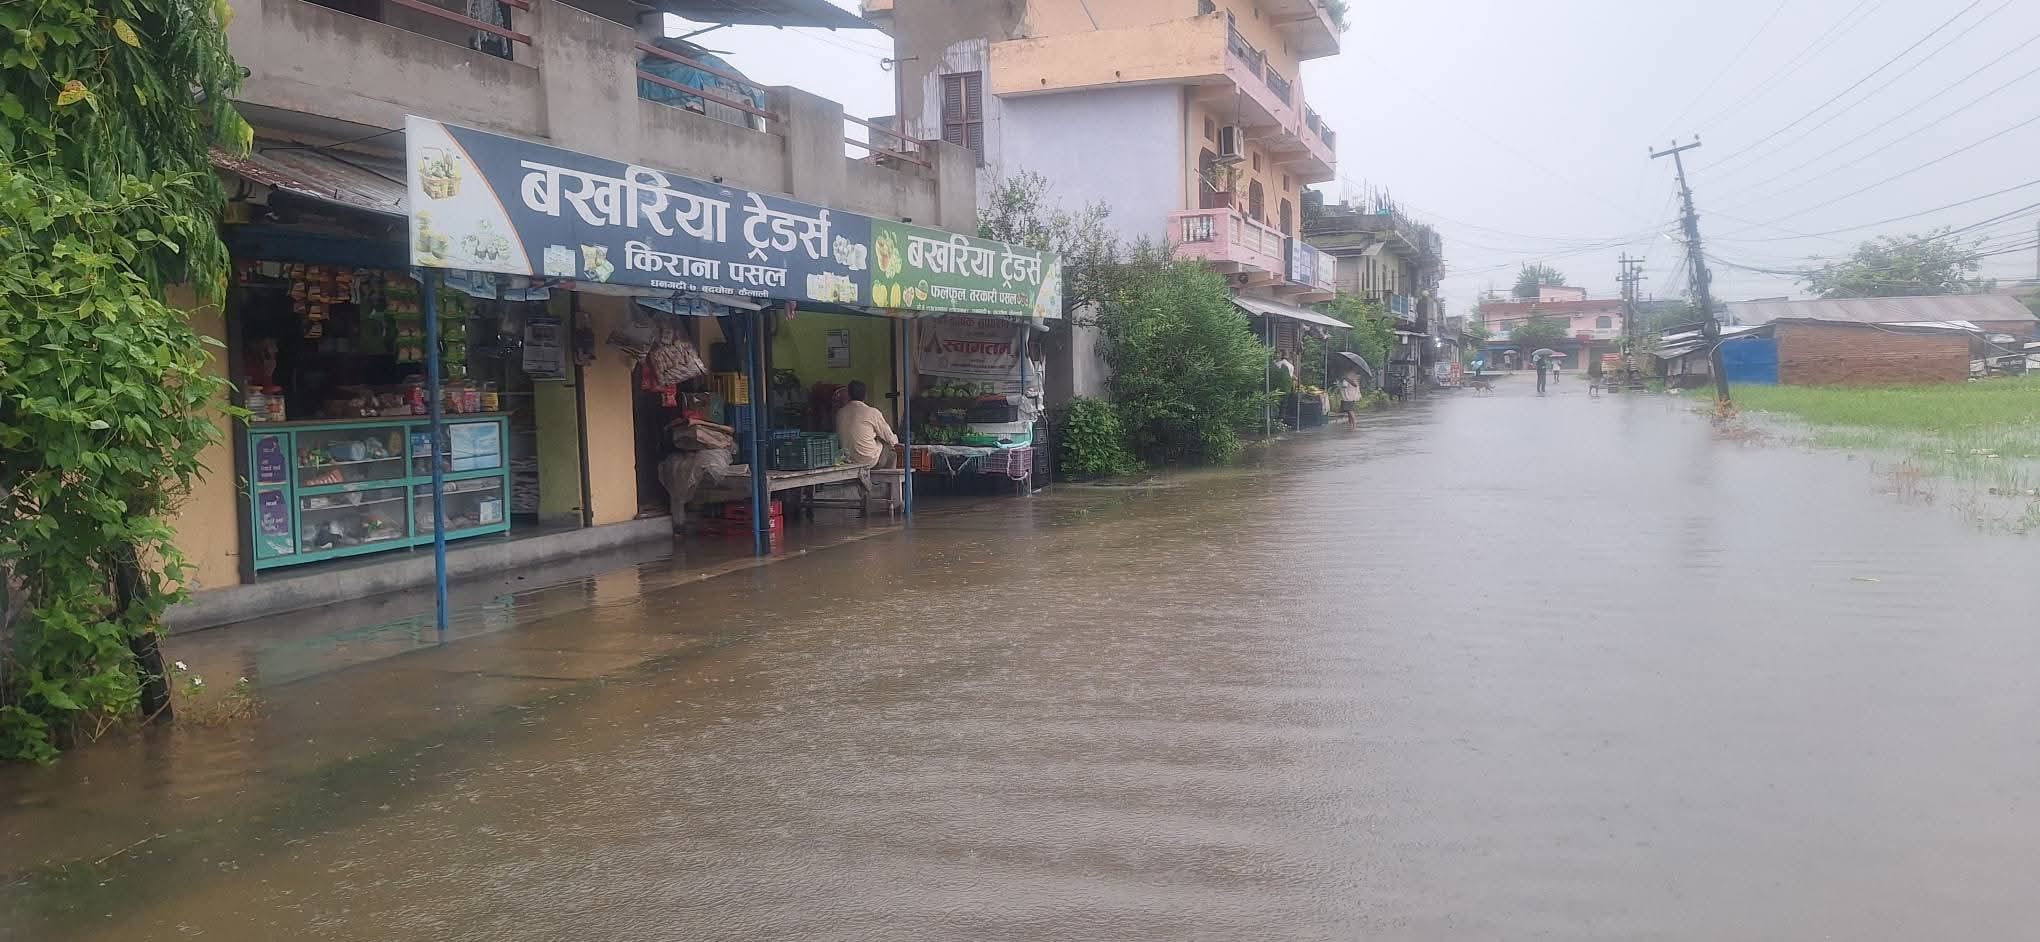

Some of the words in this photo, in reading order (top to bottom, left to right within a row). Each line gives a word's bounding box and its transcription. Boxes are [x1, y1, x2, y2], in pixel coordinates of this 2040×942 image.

[520, 160, 730, 243] बखरिया
[743, 192, 832, 262] ट्रेडर्स
[625, 240, 720, 280] किराना
[728, 262, 788, 287] पसल
[907, 233, 995, 278] बखरिया
[1000, 242, 1041, 288] ट्रेडर्स
[931, 285, 966, 304] फलफूल
[969, 288, 997, 303] तरकारी
